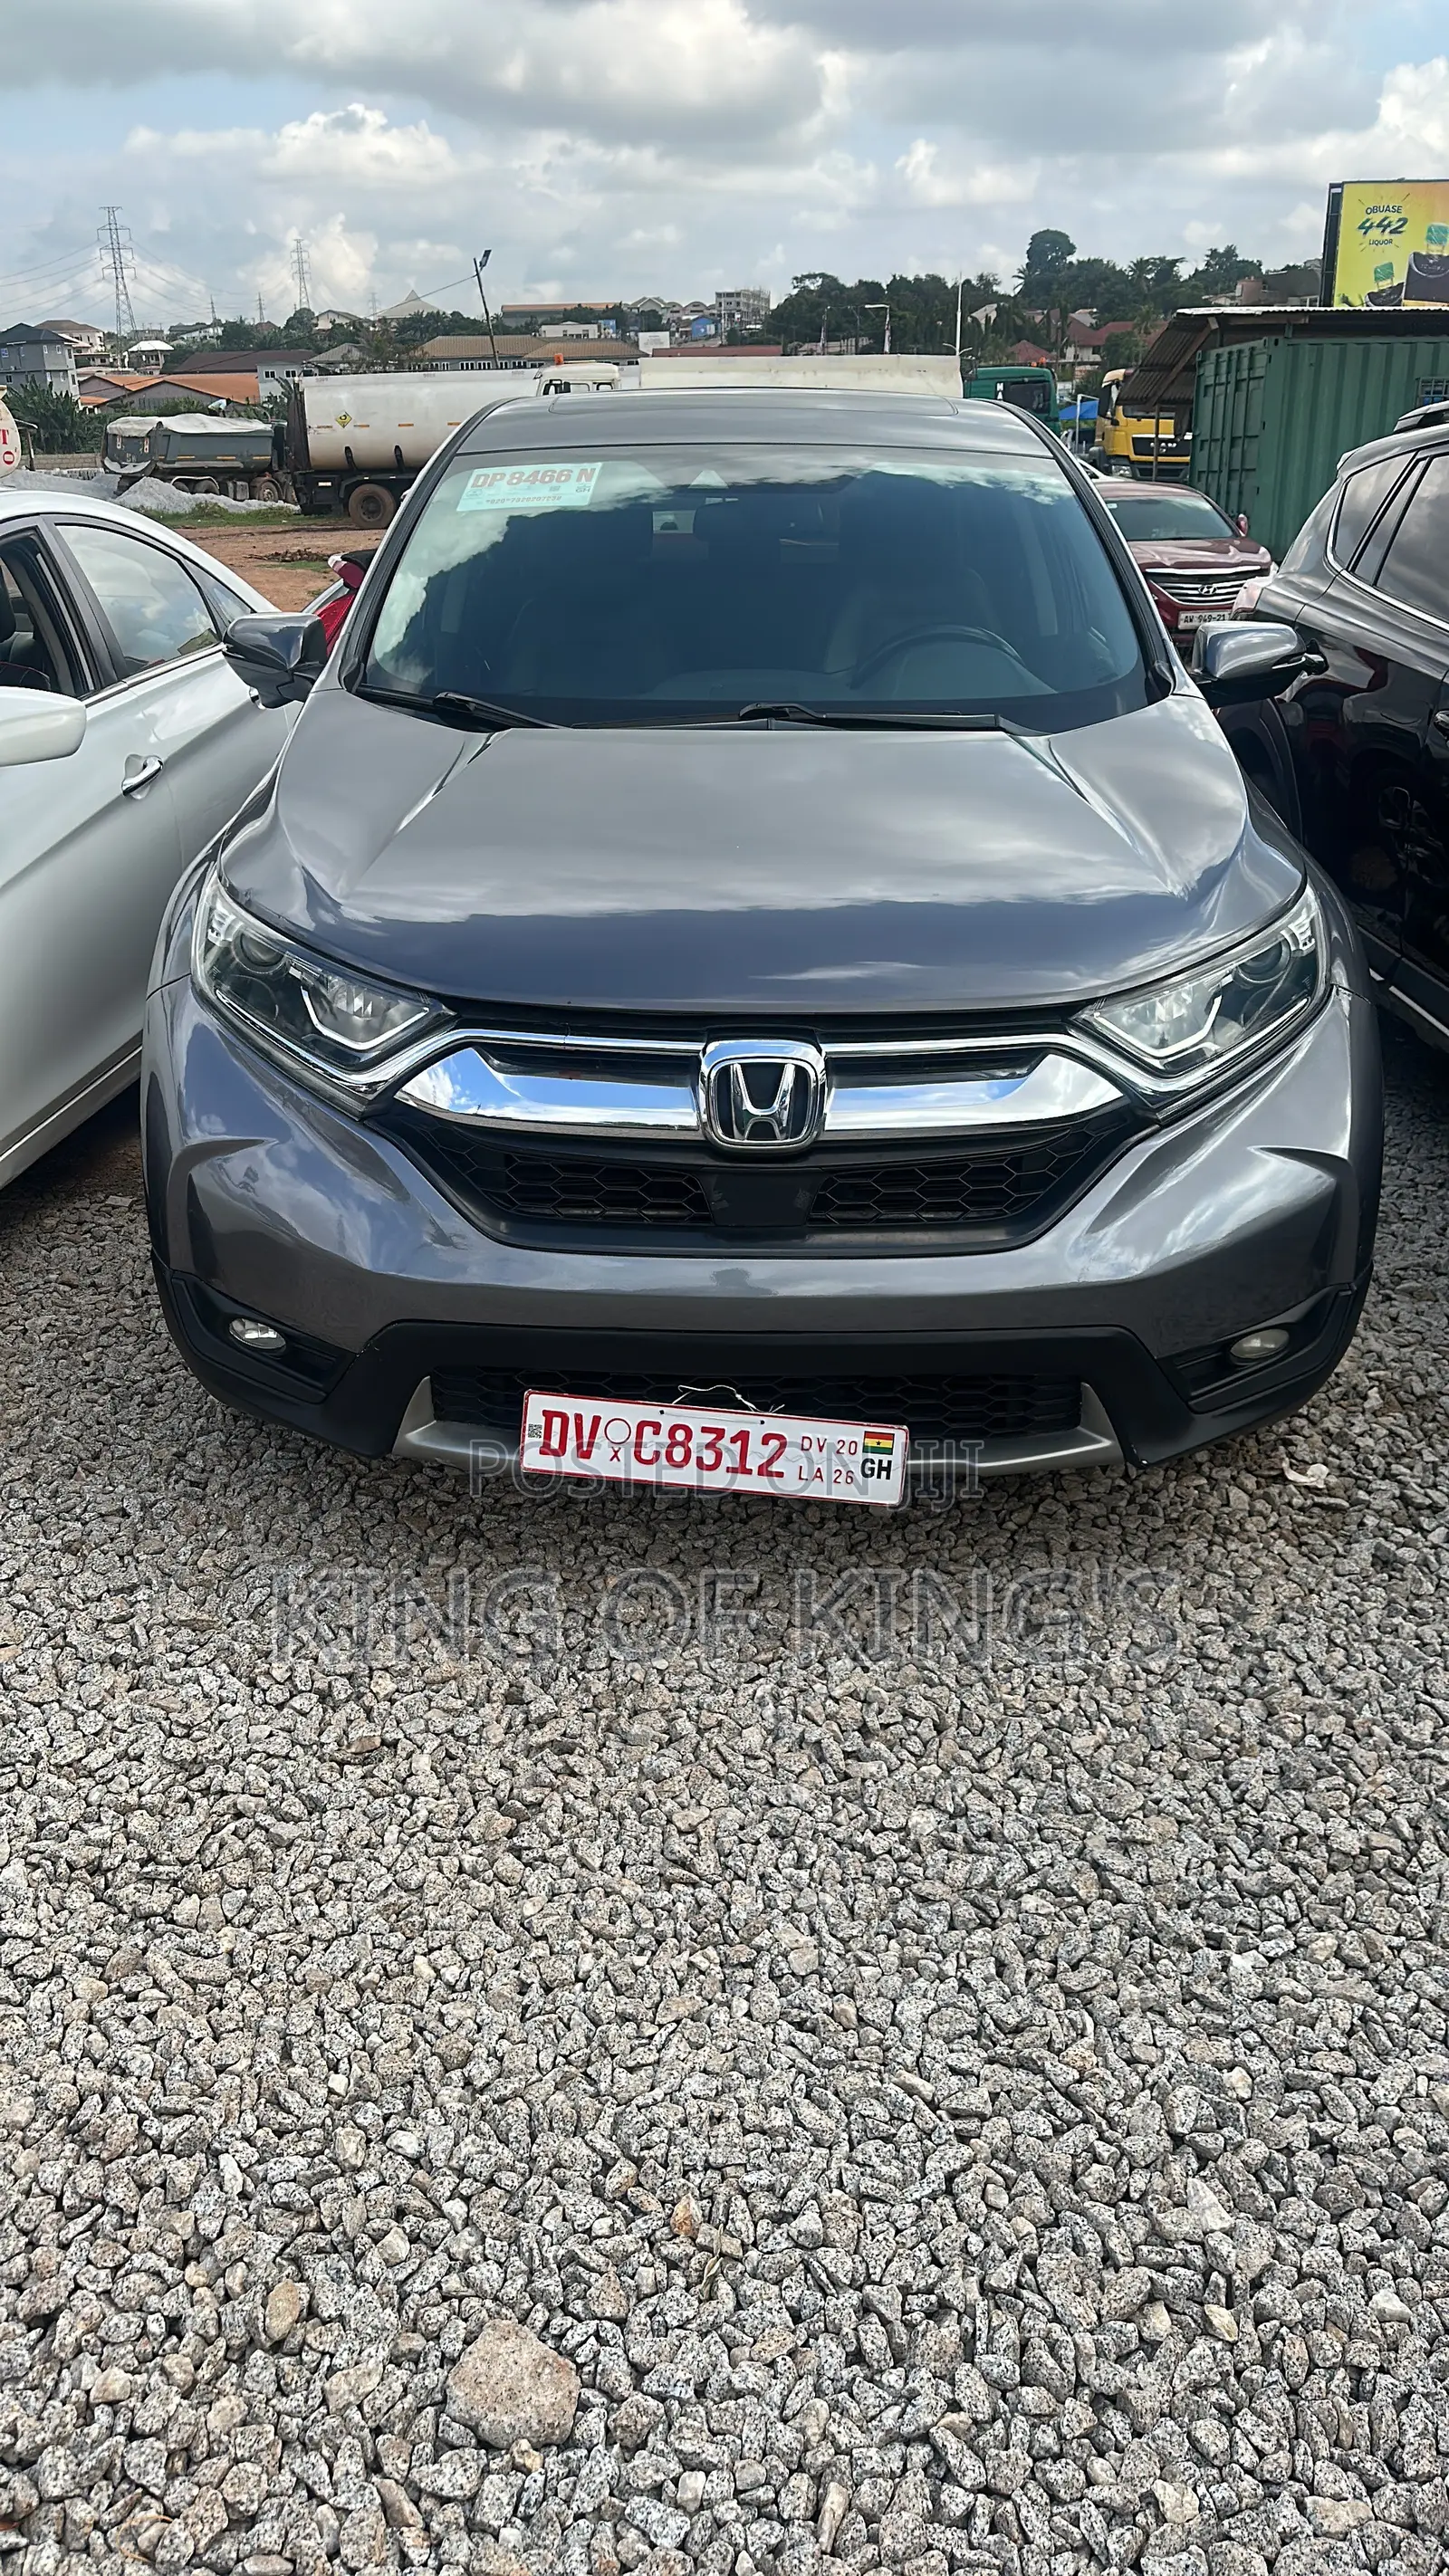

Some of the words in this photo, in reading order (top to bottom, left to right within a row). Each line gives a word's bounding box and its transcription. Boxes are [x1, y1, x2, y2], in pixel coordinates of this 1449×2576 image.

[1365, 205, 1403, 215] OBUASE
[1357, 215, 1409, 237] 442
[1368, 238, 1394, 246] LIQUOR
[470, 472, 506, 489] DP
[506, 468, 573, 486] 8466
[576, 467, 597, 483] N
[539, 1409, 602, 1460] DV
[634, 1419, 786, 1480] C8312
[800, 1435, 828, 1453] DV
[835, 1439, 859, 1456] 20
[798, 1465, 824, 1482] LA
[833, 1468, 855, 1485] 26
[859, 1457, 893, 1480] GH
